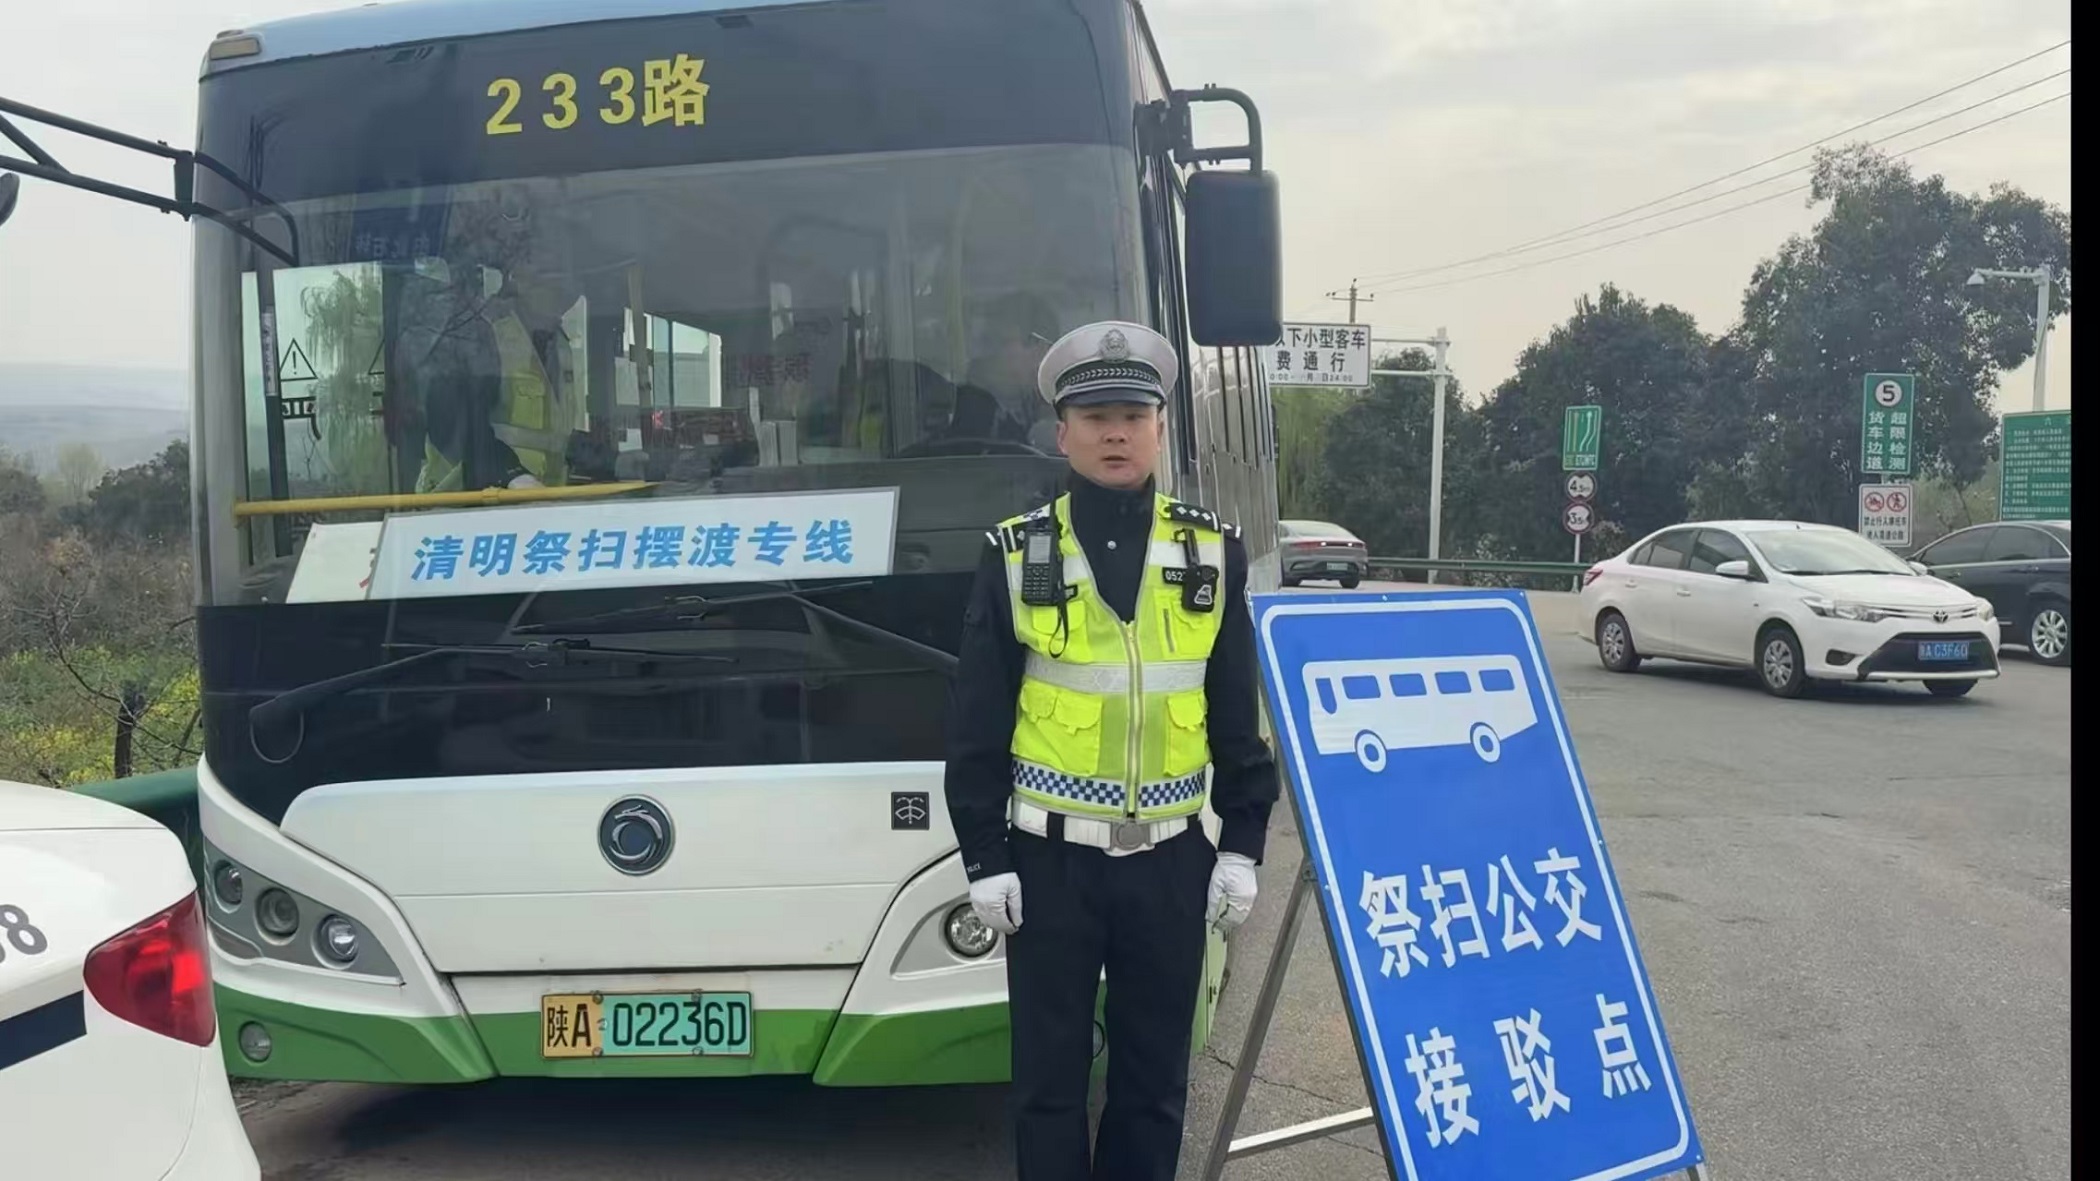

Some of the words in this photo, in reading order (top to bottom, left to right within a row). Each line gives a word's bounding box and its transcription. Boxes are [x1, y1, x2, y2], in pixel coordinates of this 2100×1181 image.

[486, 53, 710, 135] 233路
[1882, 384, 1895, 402] 5
[1866, 411, 1885, 470] 货车边道
[1889, 411, 1907, 470] 超限检测
[410, 518, 854, 582] 清明祭扫摆渡专线
[1358, 846, 1602, 979] 祭扫公交
[1403, 993, 1652, 1149] 接驳点
